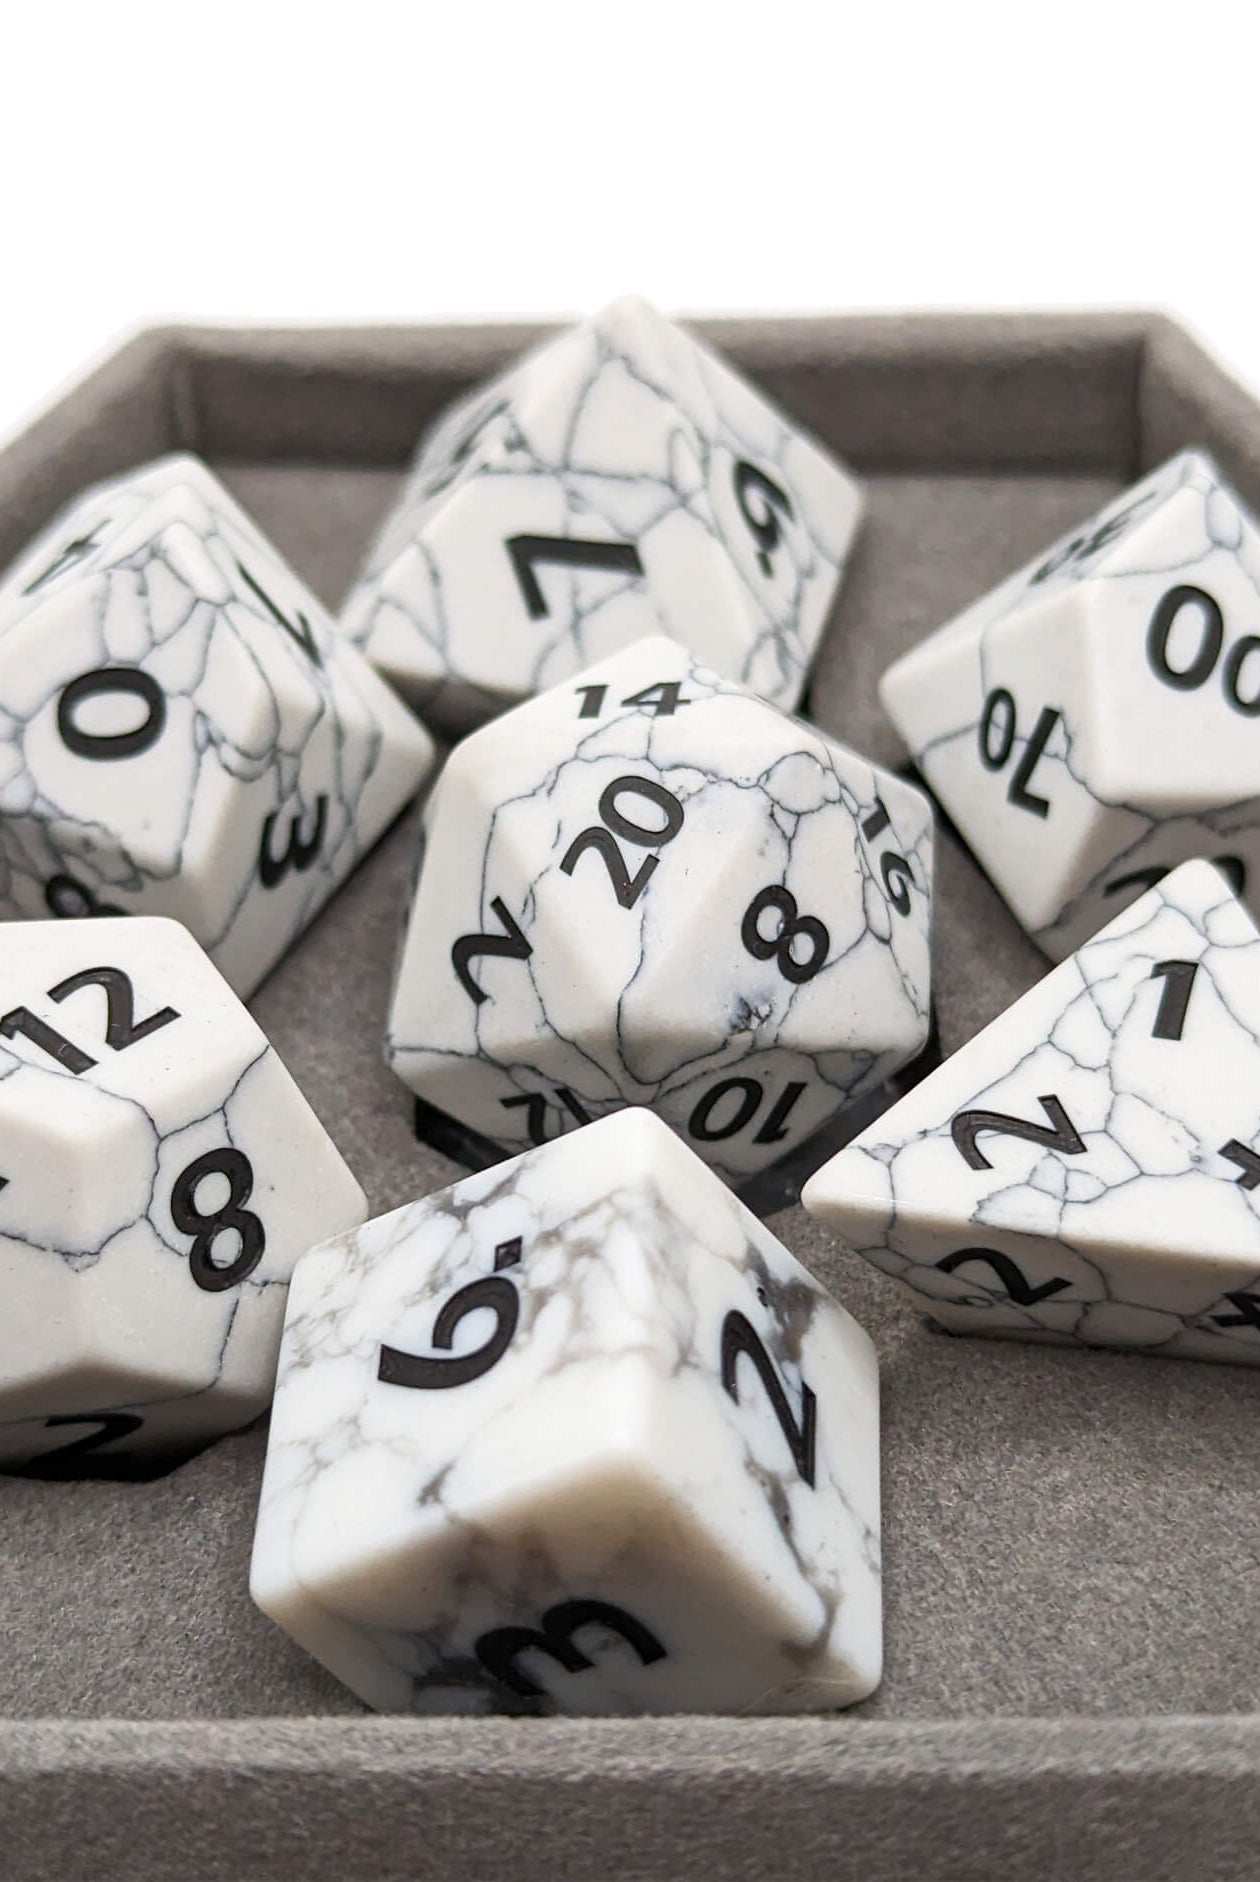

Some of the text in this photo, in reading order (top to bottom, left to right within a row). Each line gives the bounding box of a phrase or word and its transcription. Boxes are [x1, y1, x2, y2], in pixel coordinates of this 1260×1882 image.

[504, 533, 645, 621] 7
[57, 667, 167, 762] 0
[574, 680, 693, 719] 14
[978, 687, 1062, 821] 10
[258, 793, 329, 890] 3
[559, 775, 685, 911] 20
[861, 795, 917, 918] 16
[451, 895, 534, 1005] 2
[741, 884, 831, 985] 8
[0, 965, 182, 1076] 12
[1150, 959, 1200, 1041] 1
[688, 1077, 808, 1145] 10
[950, 1094, 1088, 1171] 2
[170, 1147, 267, 1293] 8
[935, 1247, 1073, 1306] 2
[719, 1308, 817, 1492] 2
[475, 1599, 668, 1697] 3
